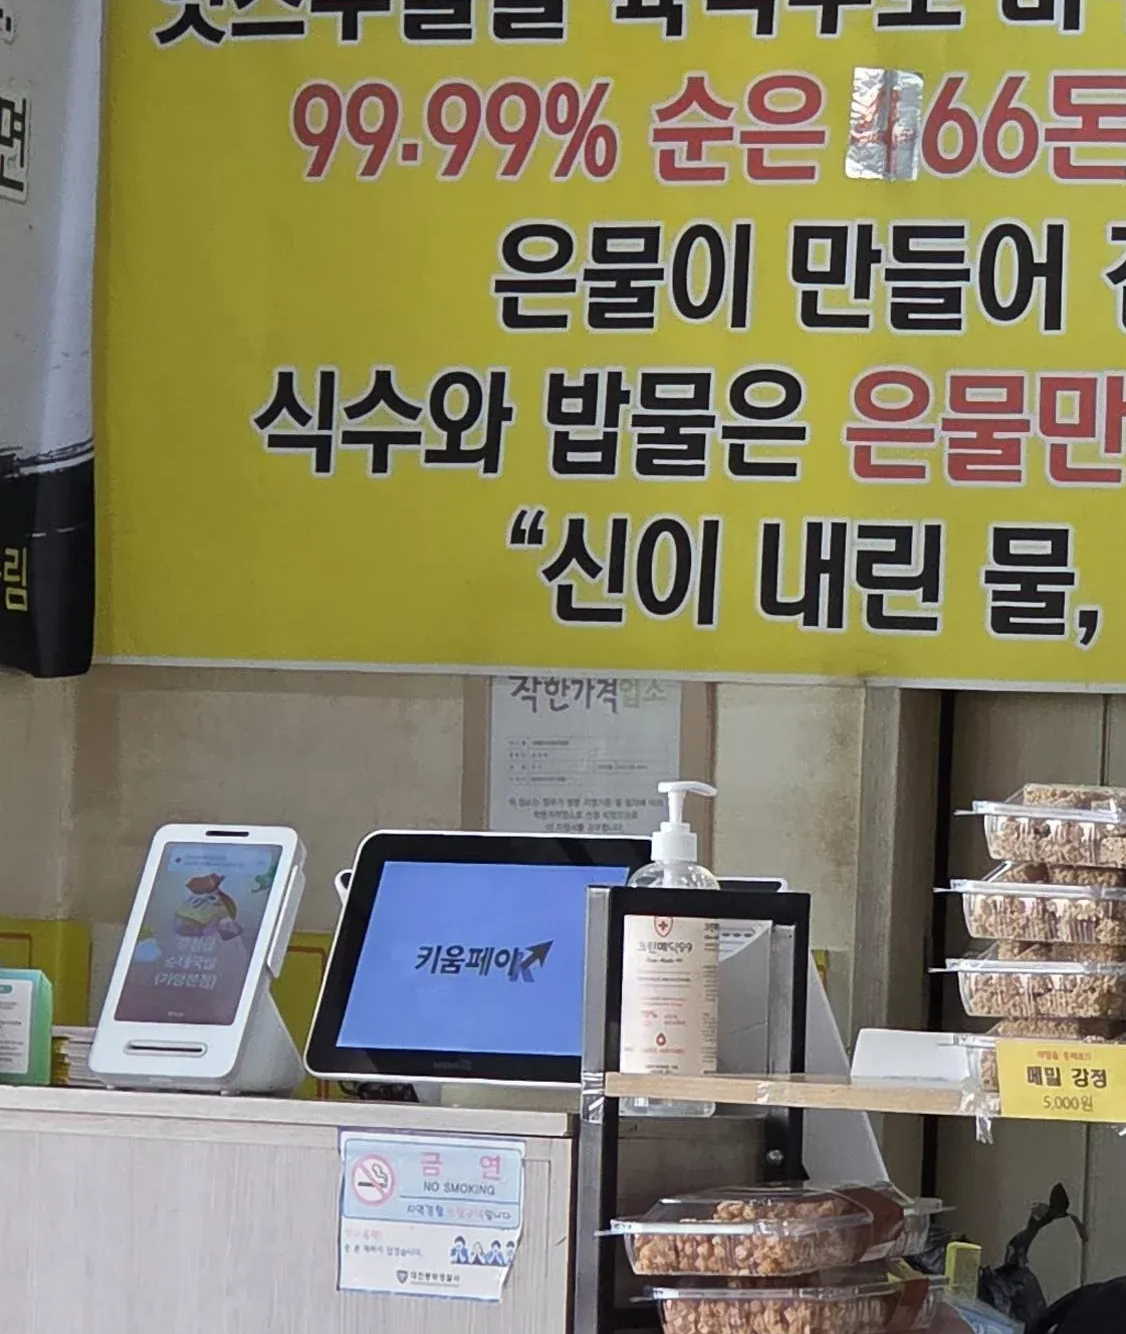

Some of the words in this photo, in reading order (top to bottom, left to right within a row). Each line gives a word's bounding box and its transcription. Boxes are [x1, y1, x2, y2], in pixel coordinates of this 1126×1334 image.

[294, 83, 616, 176] 99.99%
[653, 76, 824, 180] 순은
[495, 224, 750, 328] 은물이
[792, 224, 1063, 330] 만들어
[254, 370, 513, 473] 식수와
[547, 370, 806, 476] 밥물은
[511, 510, 719, 624] “신이
[761, 522, 941, 630] 내린
[985, 527, 1098, 645] 물,
[414, 945, 520, 977] 키움페이
[1027, 1066, 1061, 1087] 메밀
[1071, 1068, 1107, 1089] 강정
[1043, 1095, 1093, 1112] 5,000원
[420, 1152, 442, 1177] 금
[480, 1155, 502, 1181] 연
[423, 1180, 440, 1192] NO
[443, 1182, 495, 1196] SMOKING
